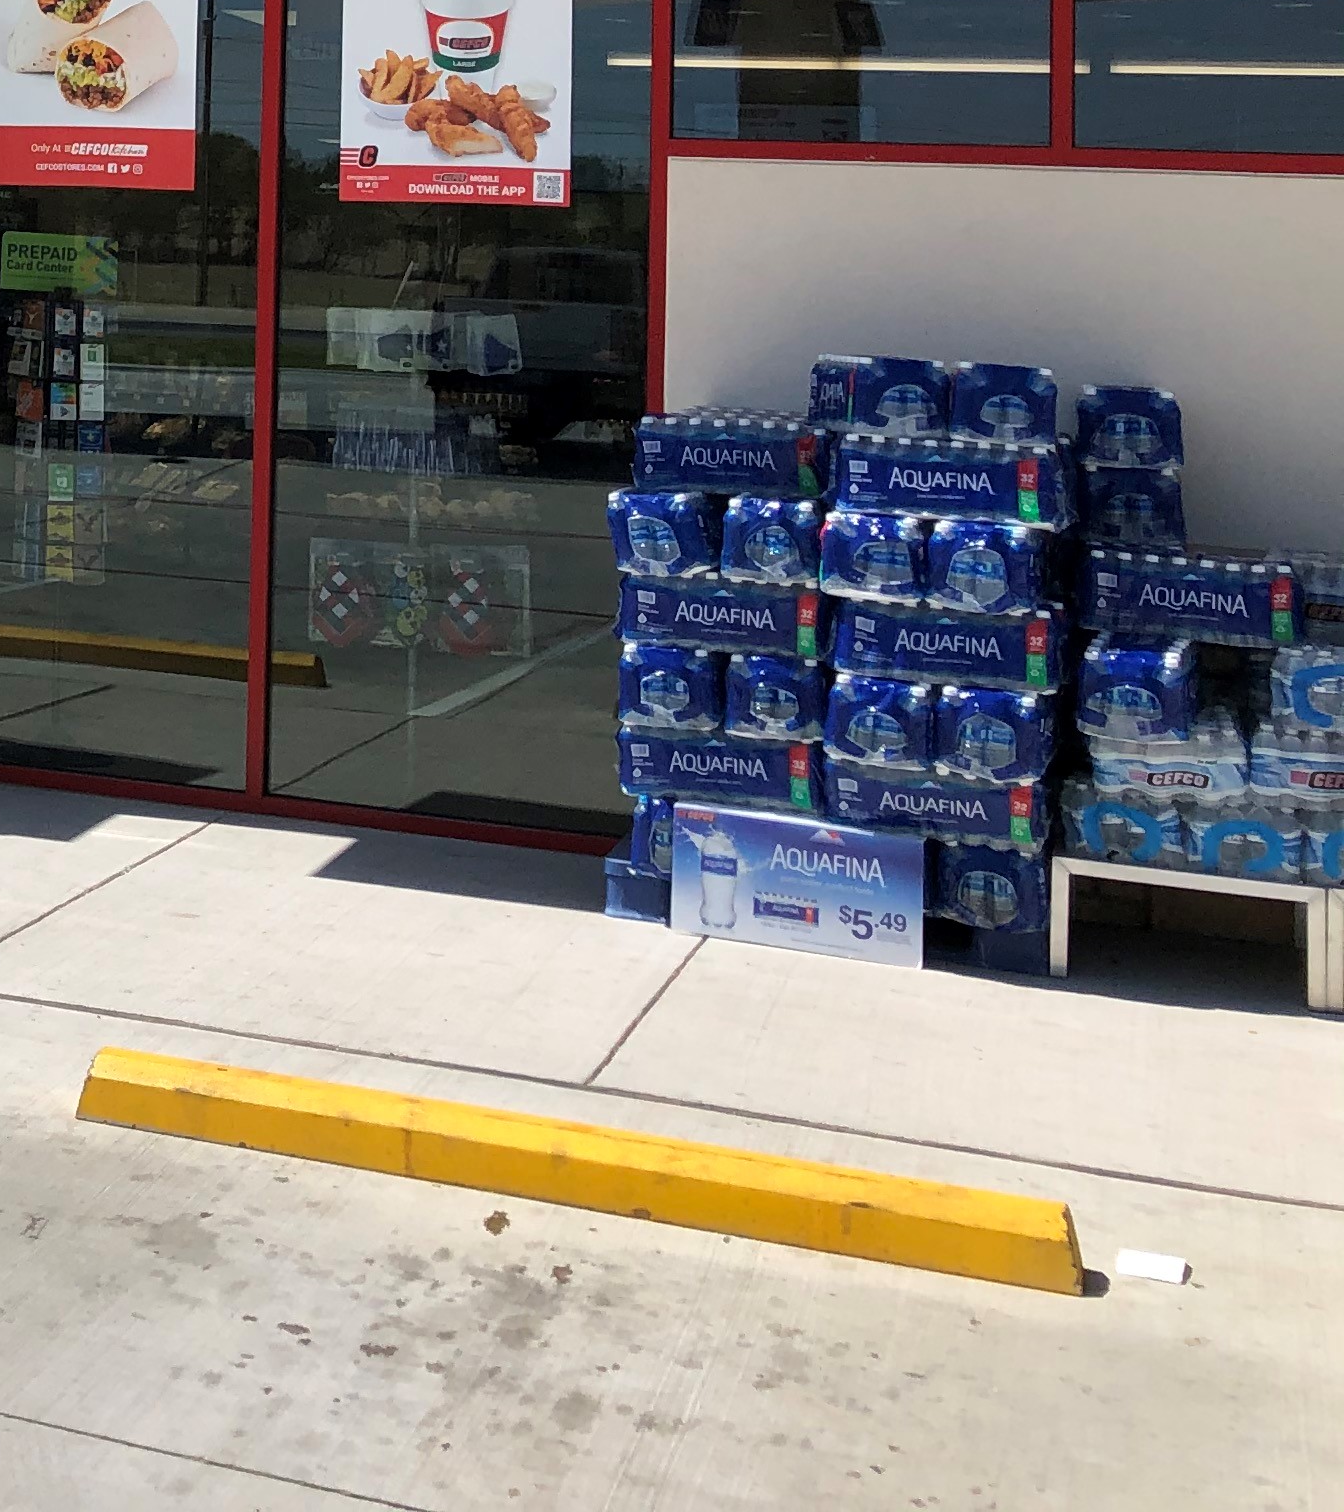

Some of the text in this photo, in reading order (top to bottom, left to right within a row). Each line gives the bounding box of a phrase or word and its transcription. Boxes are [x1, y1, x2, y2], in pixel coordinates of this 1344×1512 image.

[31, 143, 51, 154] Only
[52, 144, 61, 152] At
[409, 184, 526, 197] DOWNLOAD THE APP
[7, 243, 78, 262] PREPAID
[6, 259, 74, 273] Card Center
[681, 445, 778, 472] AQUAFINA
[888, 466, 997, 496] AQUAFINA
[1020, 473, 1034, 483] 32
[1138, 583, 1250, 619] AQUAFINA
[675, 600, 777, 632] AQUAFINA
[801, 608, 813, 619] 32
[893, 628, 1004, 661] AQUAFINA
[1029, 636, 1043, 647] 32
[669, 750, 770, 782] AQUAFINA
[791, 760, 806, 770] 32
[1151, 772, 1205, 787] CEFCO
[879, 791, 990, 822] AQUAFINA
[1013, 801, 1028, 812] 32
[770, 843, 887, 888] AQUAFINA
[838, 904, 908, 941] $5.49
